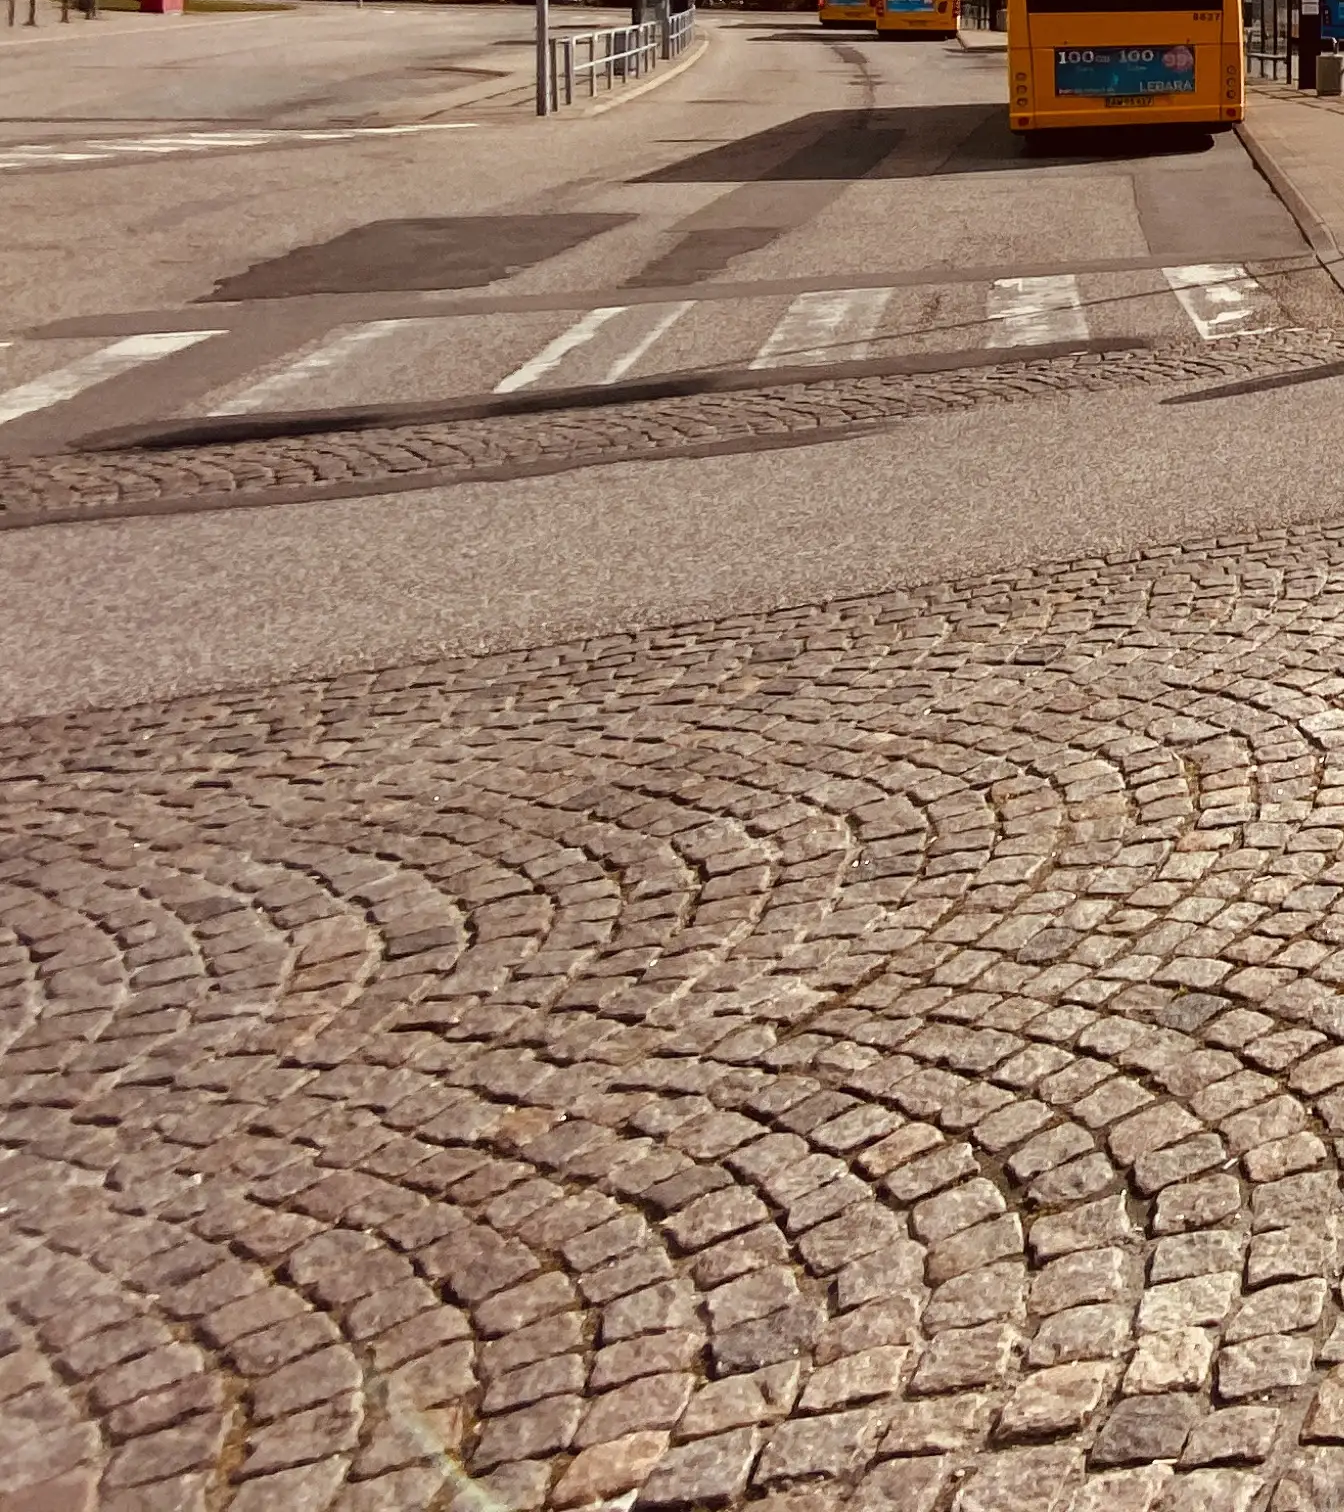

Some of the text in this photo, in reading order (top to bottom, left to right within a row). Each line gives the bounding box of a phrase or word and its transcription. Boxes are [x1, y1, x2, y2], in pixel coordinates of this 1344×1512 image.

[1058, 50, 1095, 65] 100
[1118, 49, 1155, 63] 100
[1140, 79, 1193, 93] LEBARA
